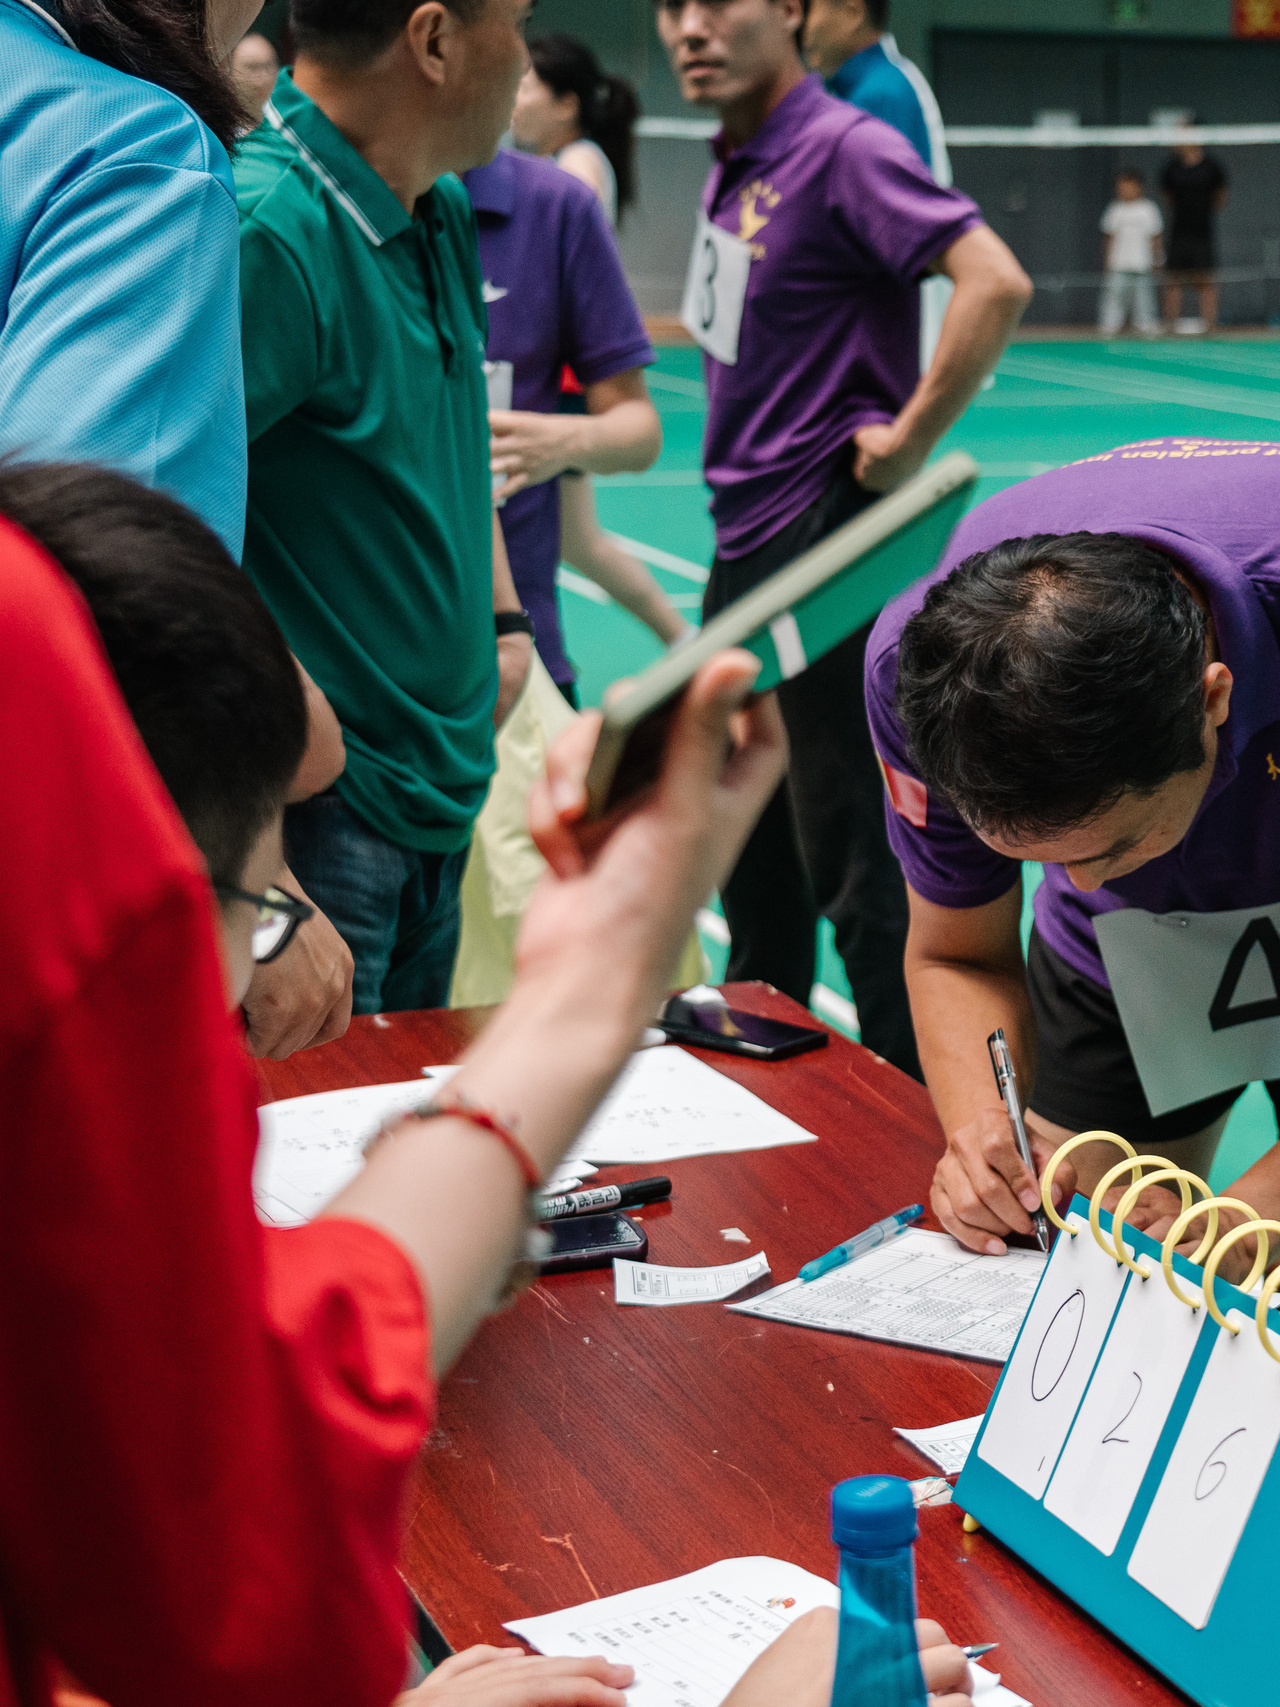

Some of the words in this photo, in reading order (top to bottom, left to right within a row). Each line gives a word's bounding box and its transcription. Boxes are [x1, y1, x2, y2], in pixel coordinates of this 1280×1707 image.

[1121, 446, 1261, 460] precision
[1030, 1288, 1086, 1402] 0
[1101, 1371, 1143, 1444] 2
[1194, 1427, 1247, 1501] 6
